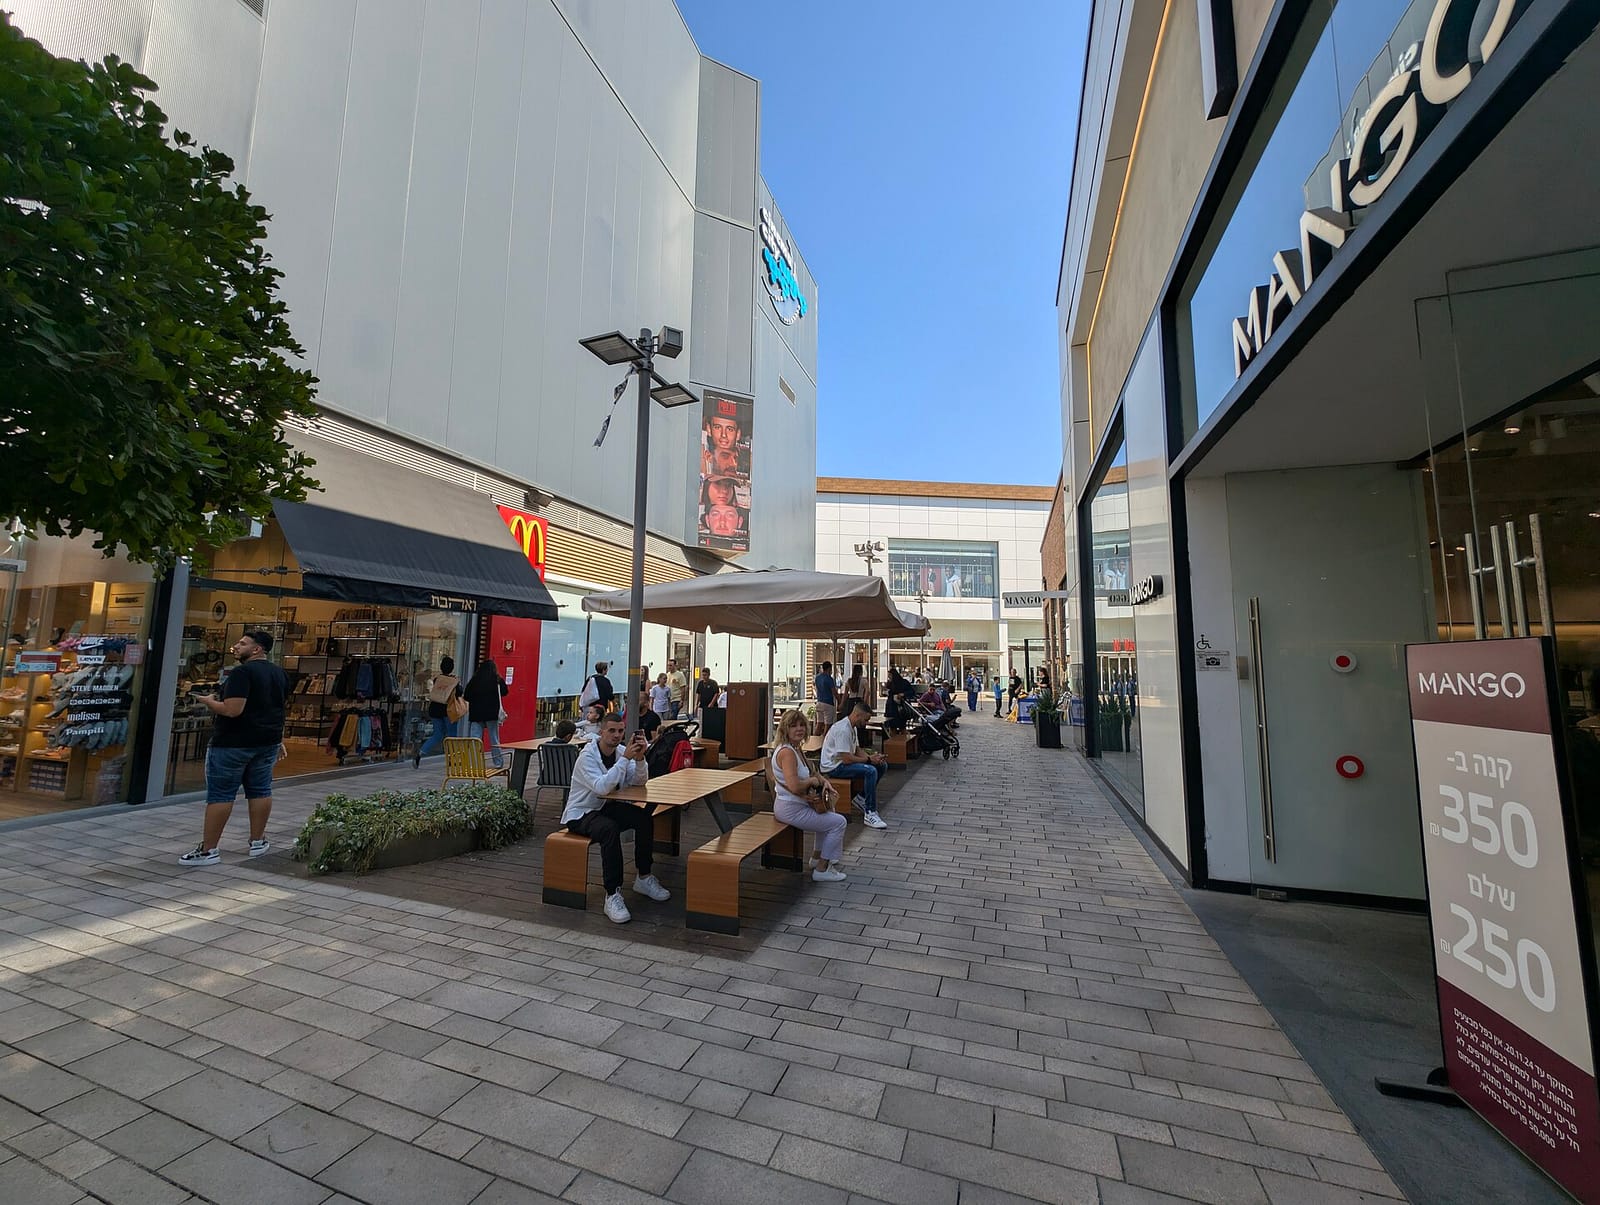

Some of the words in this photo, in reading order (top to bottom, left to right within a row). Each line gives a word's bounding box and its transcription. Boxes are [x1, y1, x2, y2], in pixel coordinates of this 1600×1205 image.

[1233, 0, 1513, 379] MANGO
[1004, 596, 1041, 605] MANGO
[1129, 575, 1154, 606] MANGO
[1418, 672, 1526, 698] MANGO
[67, 711, 100, 721] melissa
[1472, 753, 1513, 789] קנה
[1467, 873, 1516, 911] שלם
[1454, 1007, 1479, 1029] מבצעים
[1456, 1035, 1465, 1047] לא
[1469, 1031, 1479, 1043] לא
[1478, 1022, 1493, 1040] כפל
[1493, 1034, 1503, 1048] אין
[1508, 1060, 1530, 1081] לממש
[1534, 1064, 1545, 1078] עד
[1531, 1077, 1546, 1094] ניתן
[1546, 1072, 1574, 1099] בתוקף
[1502, 1085, 1526, 1109] כרטיסי
[1502, 1098, 1528, 1125] פריטים
[1528, 1105, 1553, 1131] רכישת
[1554, 1110, 1578, 1134] פריטי
[1553, 1123, 1565, 1140] על
[1566, 1134, 1581, 1153] חל
